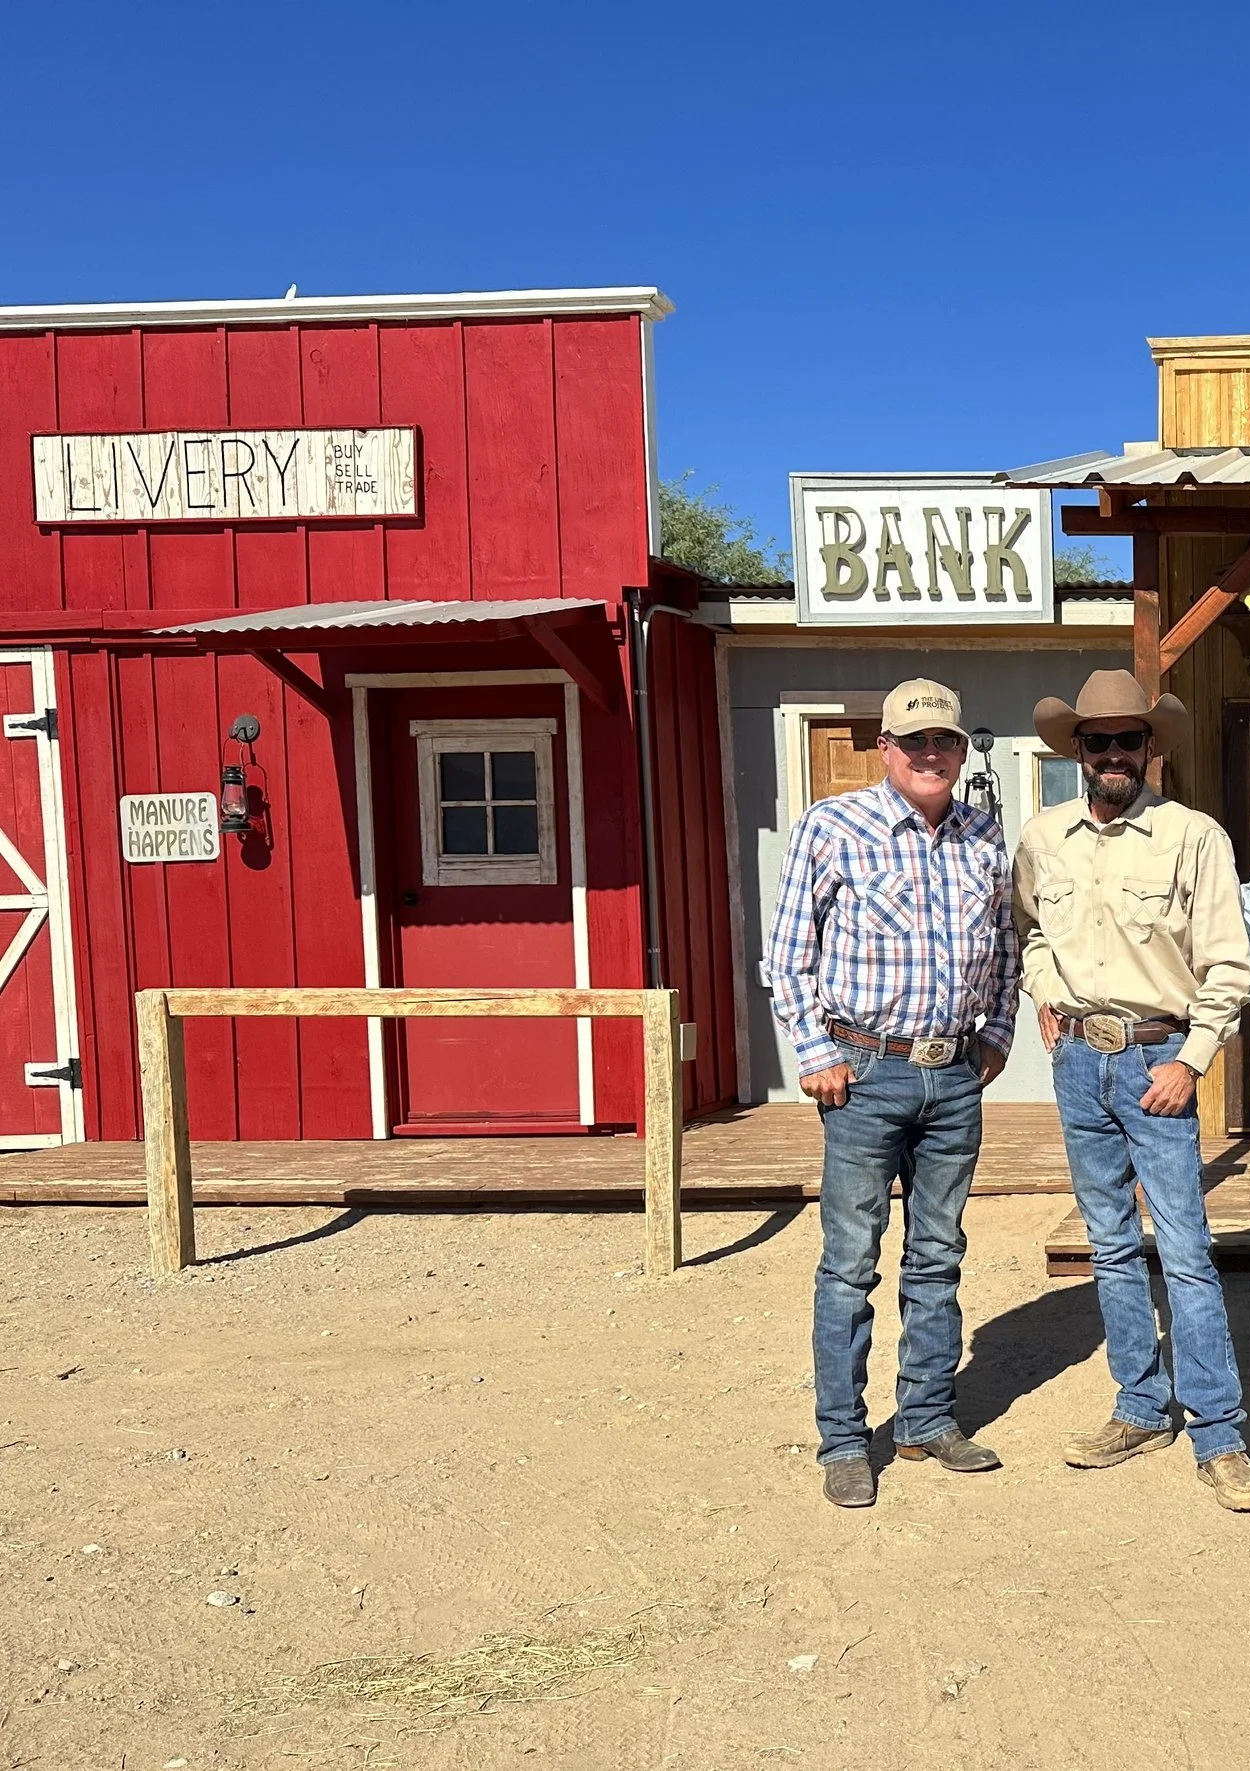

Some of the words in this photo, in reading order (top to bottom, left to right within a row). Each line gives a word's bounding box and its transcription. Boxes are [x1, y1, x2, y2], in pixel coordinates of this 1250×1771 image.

[334, 444, 364, 459] BUY
[67, 438, 300, 511] LIVERY
[335, 464, 373, 478] SELL
[334, 480, 378, 494] TRADE
[815, 505, 1033, 602] BANK
[130, 798, 209, 826] MANURE
[128, 828, 215, 857] HAPPENS
